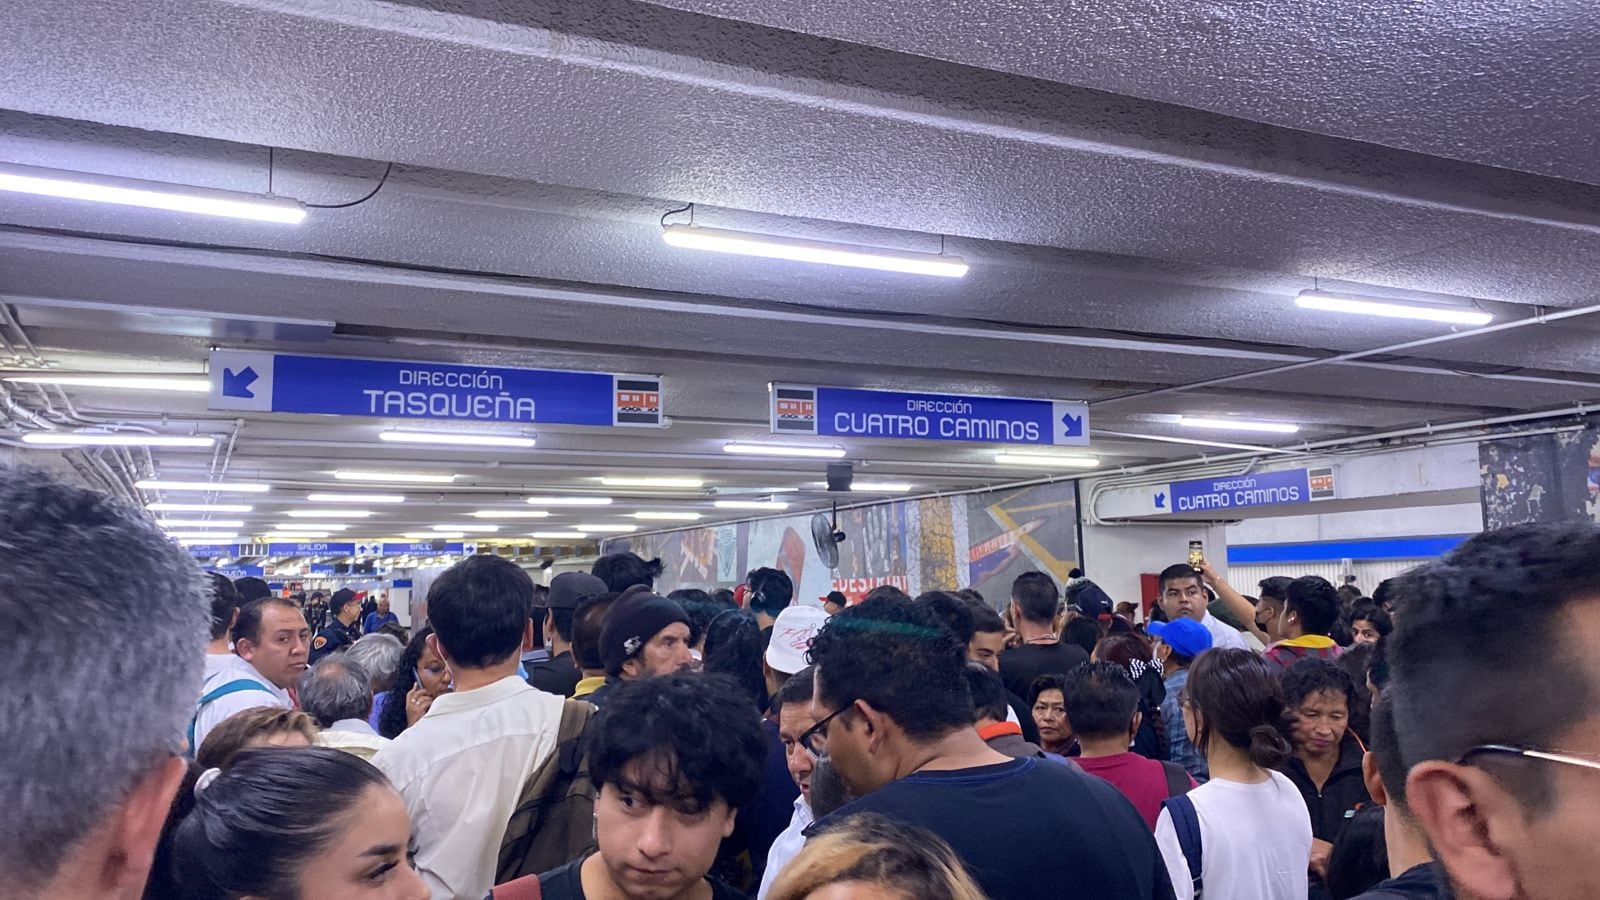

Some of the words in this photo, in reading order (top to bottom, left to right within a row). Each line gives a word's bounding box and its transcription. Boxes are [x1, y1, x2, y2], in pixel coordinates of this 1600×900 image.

[399, 369, 503, 390] DIRECCIÓN
[363, 388, 535, 420] TASQUEÑA
[906, 399, 972, 415] DIRECCIÓN
[834, 411, 930, 435] CUATRO
[939, 417, 1040, 441] CAMINOS
[1212, 478, 1257, 492] DIRECCIÓN
[1178, 492, 1230, 511] CUATRO
[1234, 486, 1300, 506] CAMINOS
[297, 543, 328, 551] SALIDA
[409, 543, 433, 551] SALID
